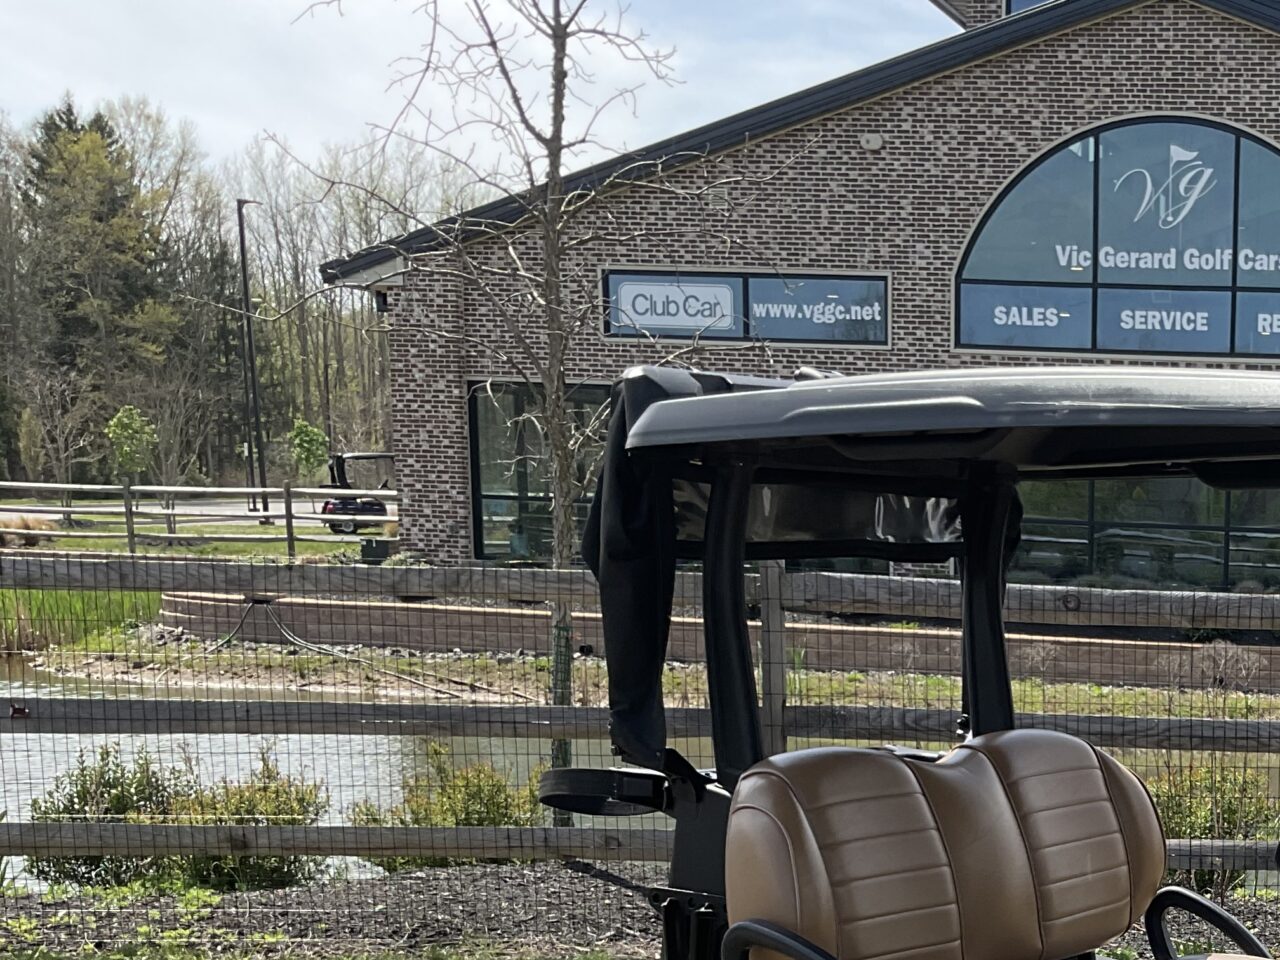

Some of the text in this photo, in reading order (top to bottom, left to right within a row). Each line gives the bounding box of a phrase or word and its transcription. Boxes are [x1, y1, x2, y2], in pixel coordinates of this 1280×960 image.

[1055, 244, 1092, 268] Vic
[1099, 246, 1177, 271] Gerard
[1183, 247, 1234, 271] Golf
[631, 293, 721, 319] Club Car
[752, 301, 882, 324] www.vggc.net
[993, 305, 1060, 327] SALES
[1119, 309, 1209, 332] SERVICE
